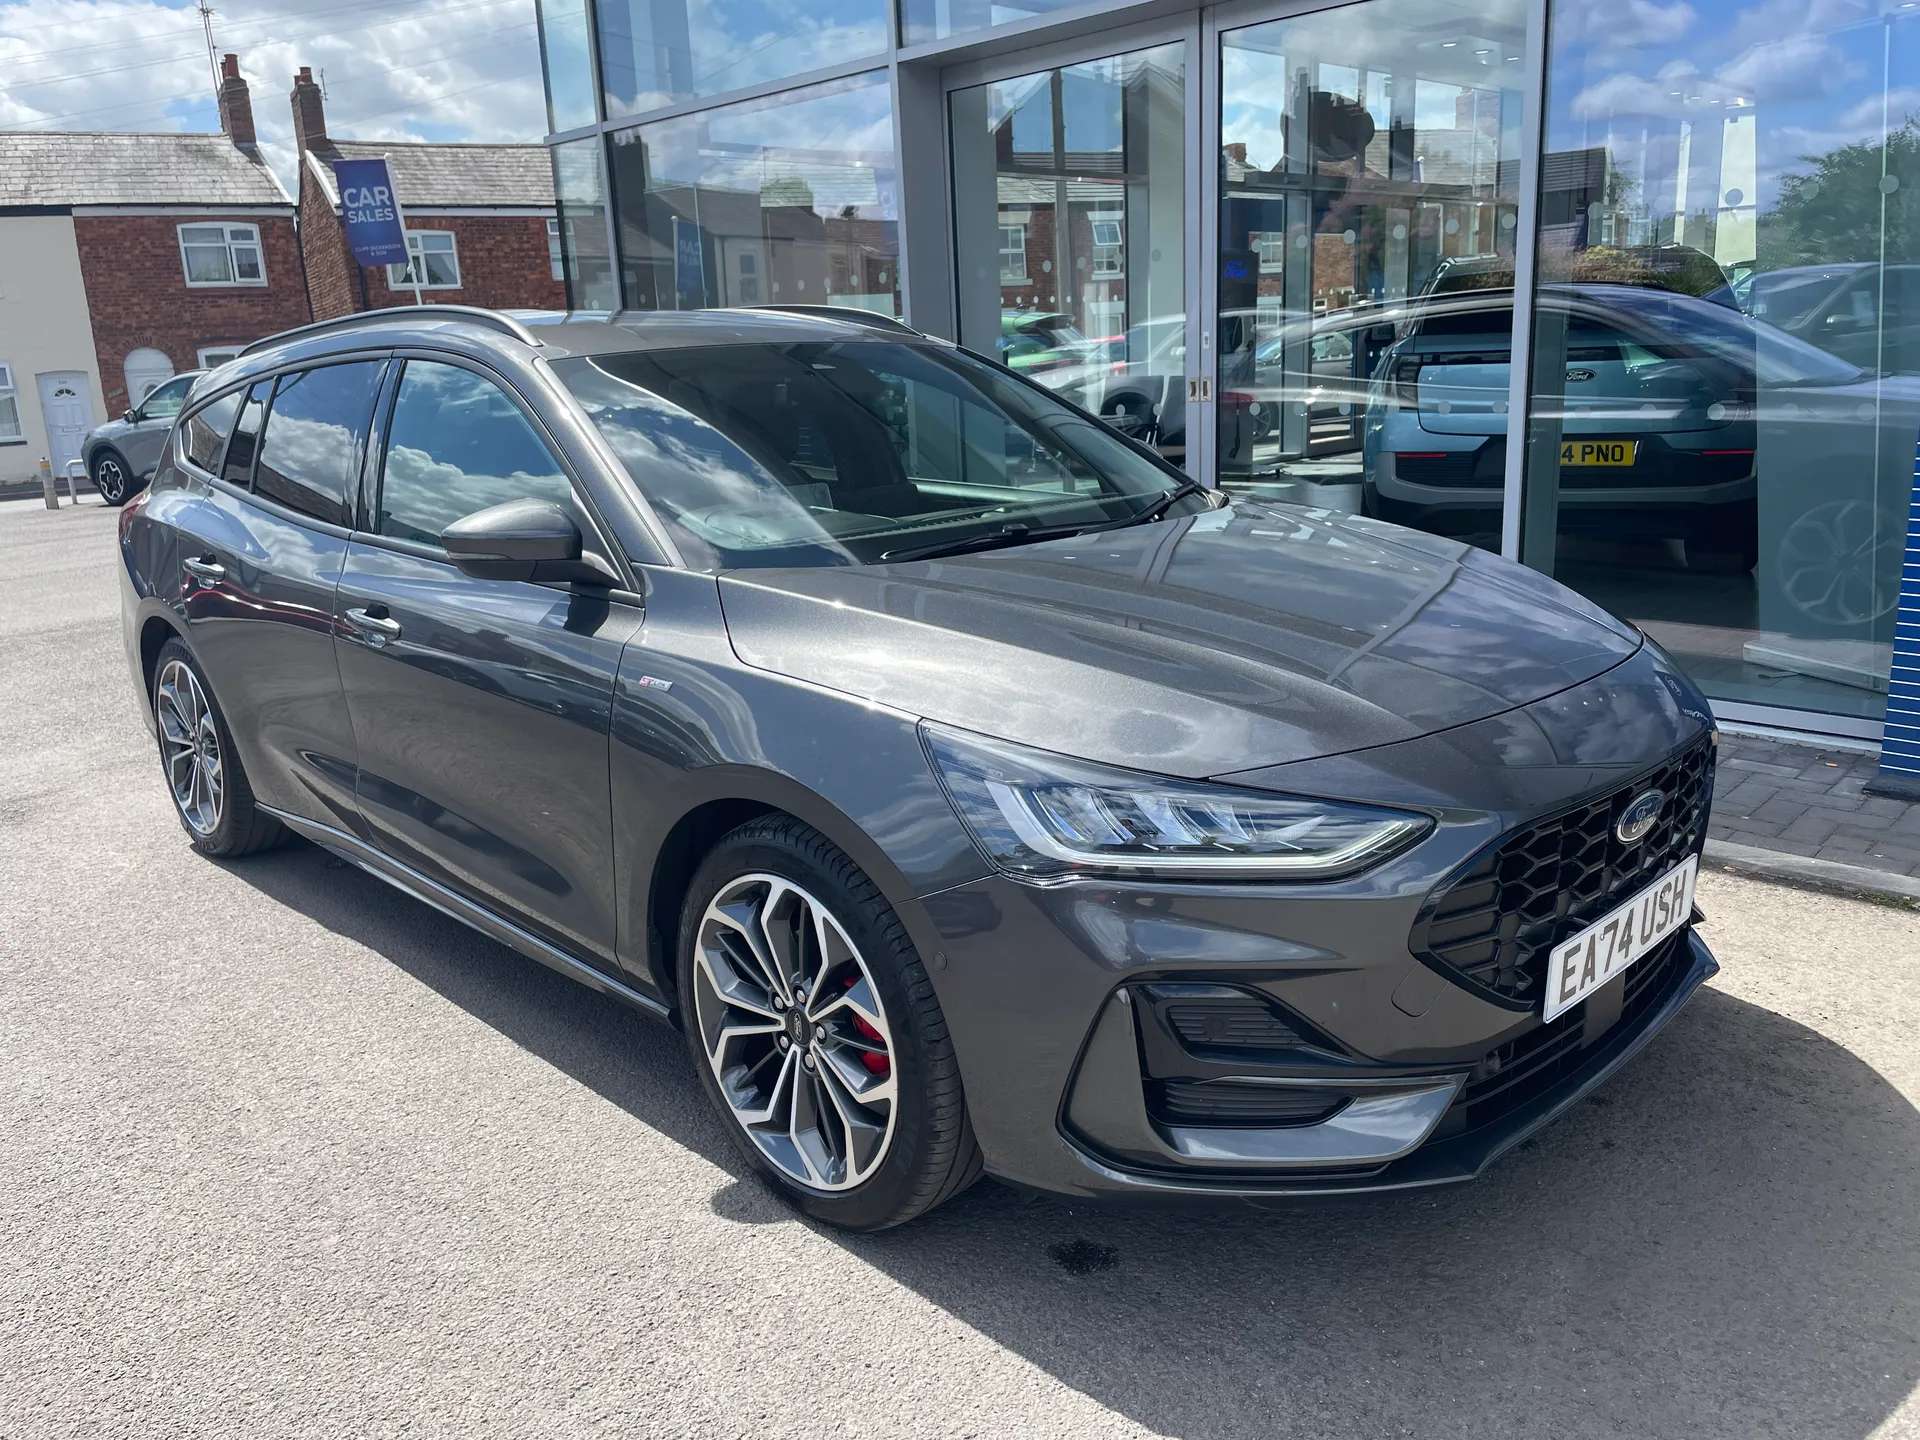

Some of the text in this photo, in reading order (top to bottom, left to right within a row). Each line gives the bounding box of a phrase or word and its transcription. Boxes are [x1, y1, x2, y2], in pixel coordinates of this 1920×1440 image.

[344, 186, 391, 208] CAR
[348, 208, 394, 224] SALES
[1581, 444, 1625, 462] PNO
[1558, 868, 1688, 1005] EA74 USH
